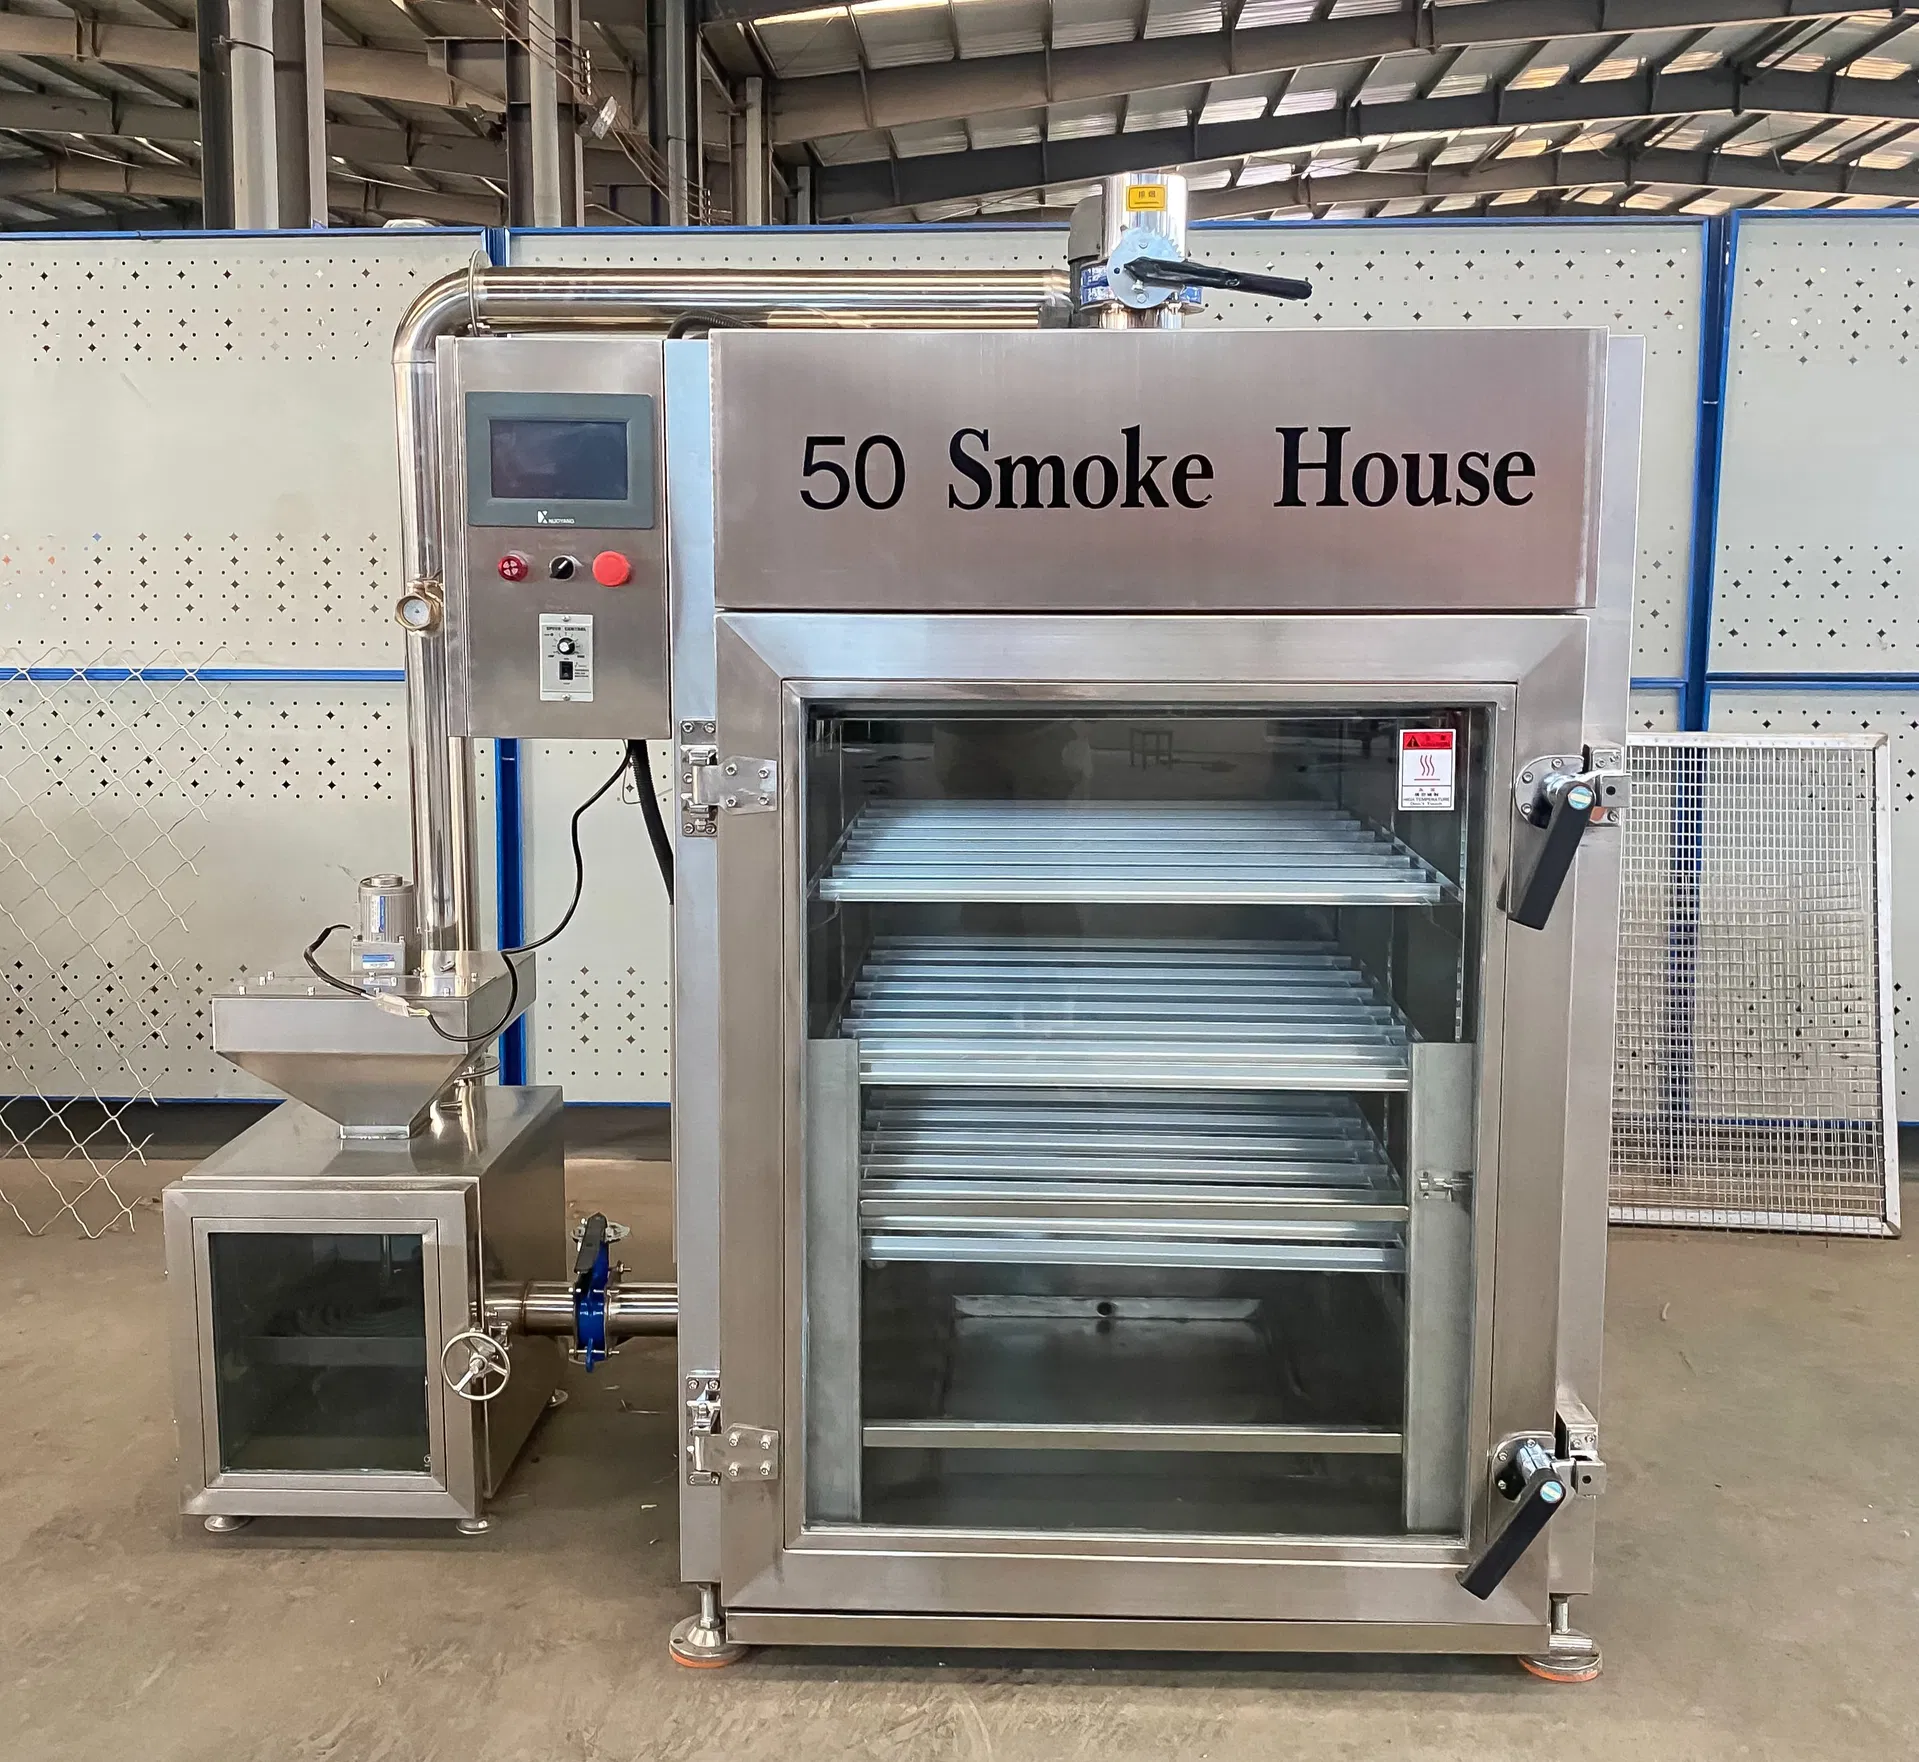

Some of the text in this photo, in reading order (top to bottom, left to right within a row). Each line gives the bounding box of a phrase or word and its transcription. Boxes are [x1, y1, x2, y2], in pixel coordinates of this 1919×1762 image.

[799, 424, 1536, 511] 50 Smoke House
